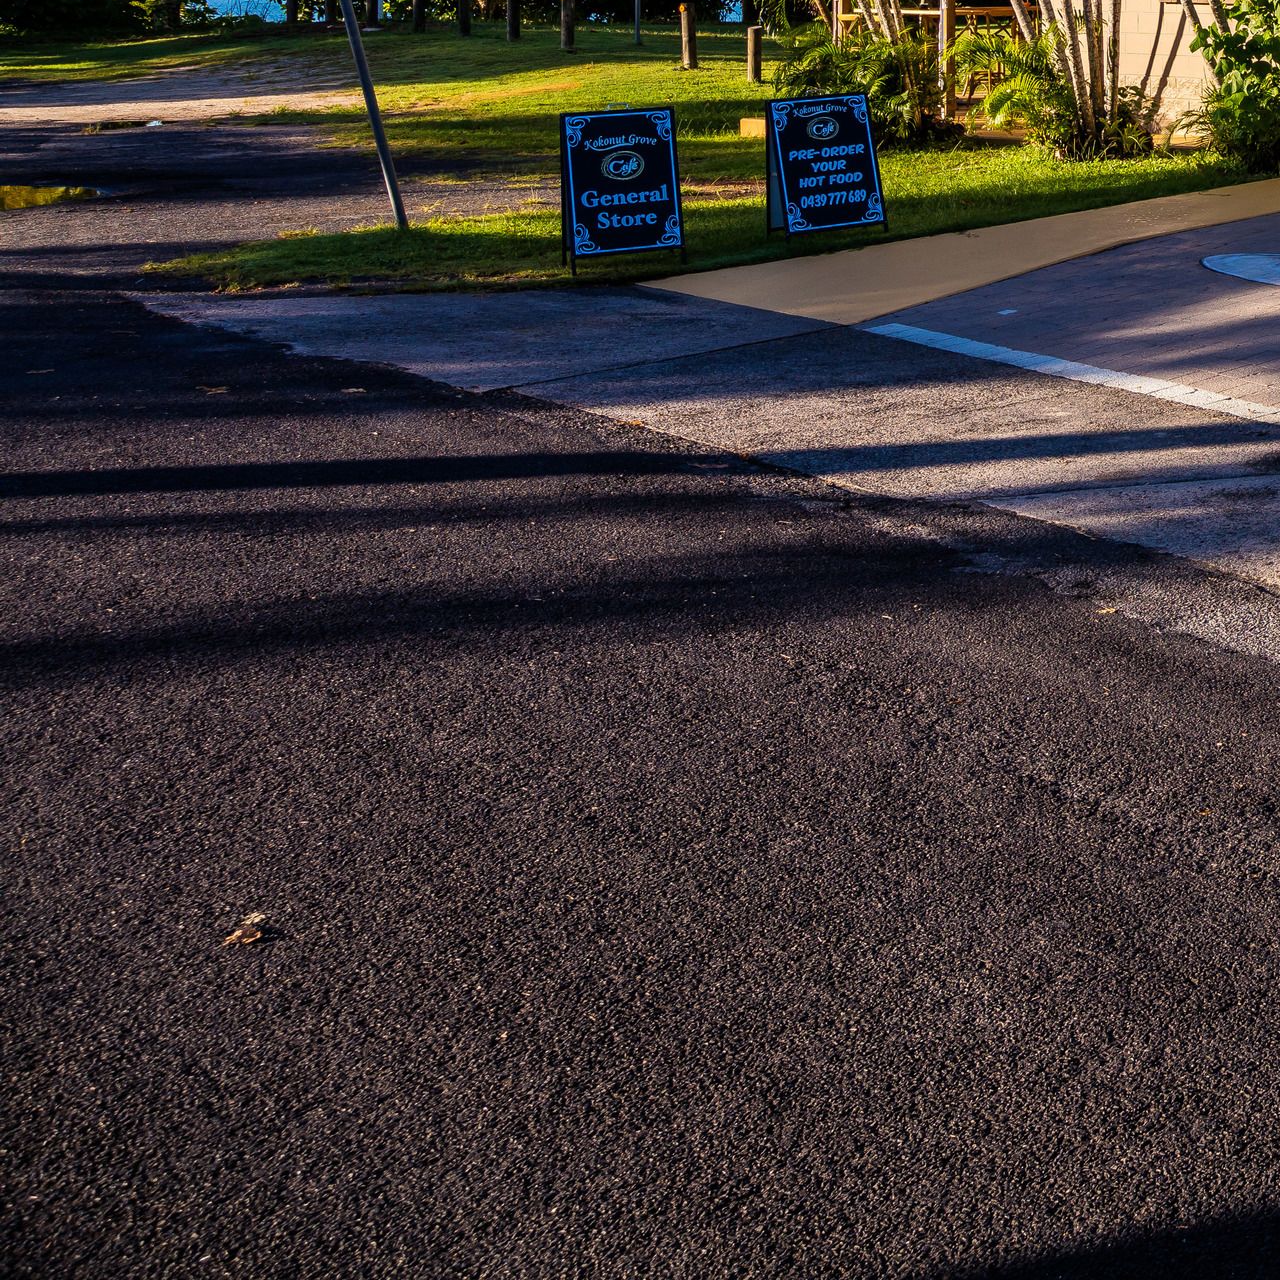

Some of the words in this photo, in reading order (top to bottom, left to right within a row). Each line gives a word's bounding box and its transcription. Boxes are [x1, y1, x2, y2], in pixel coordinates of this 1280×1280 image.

[793, 104, 824, 118] Kokonut
[825, 103, 848, 113] Grove
[584, 134, 626, 151] Kokonut
[628, 133, 657, 146] Grove
[788, 143, 865, 161] PRE-ORDER
[811, 159, 847, 173] YOUR
[799, 175, 826, 188] HOT
[829, 172, 864, 185] FOOD
[580, 183, 669, 208] General
[800, 193, 827, 209] 0439
[827, 191, 847, 206] 777
[848, 189, 867, 203] 689
[597, 211, 658, 229] Store
